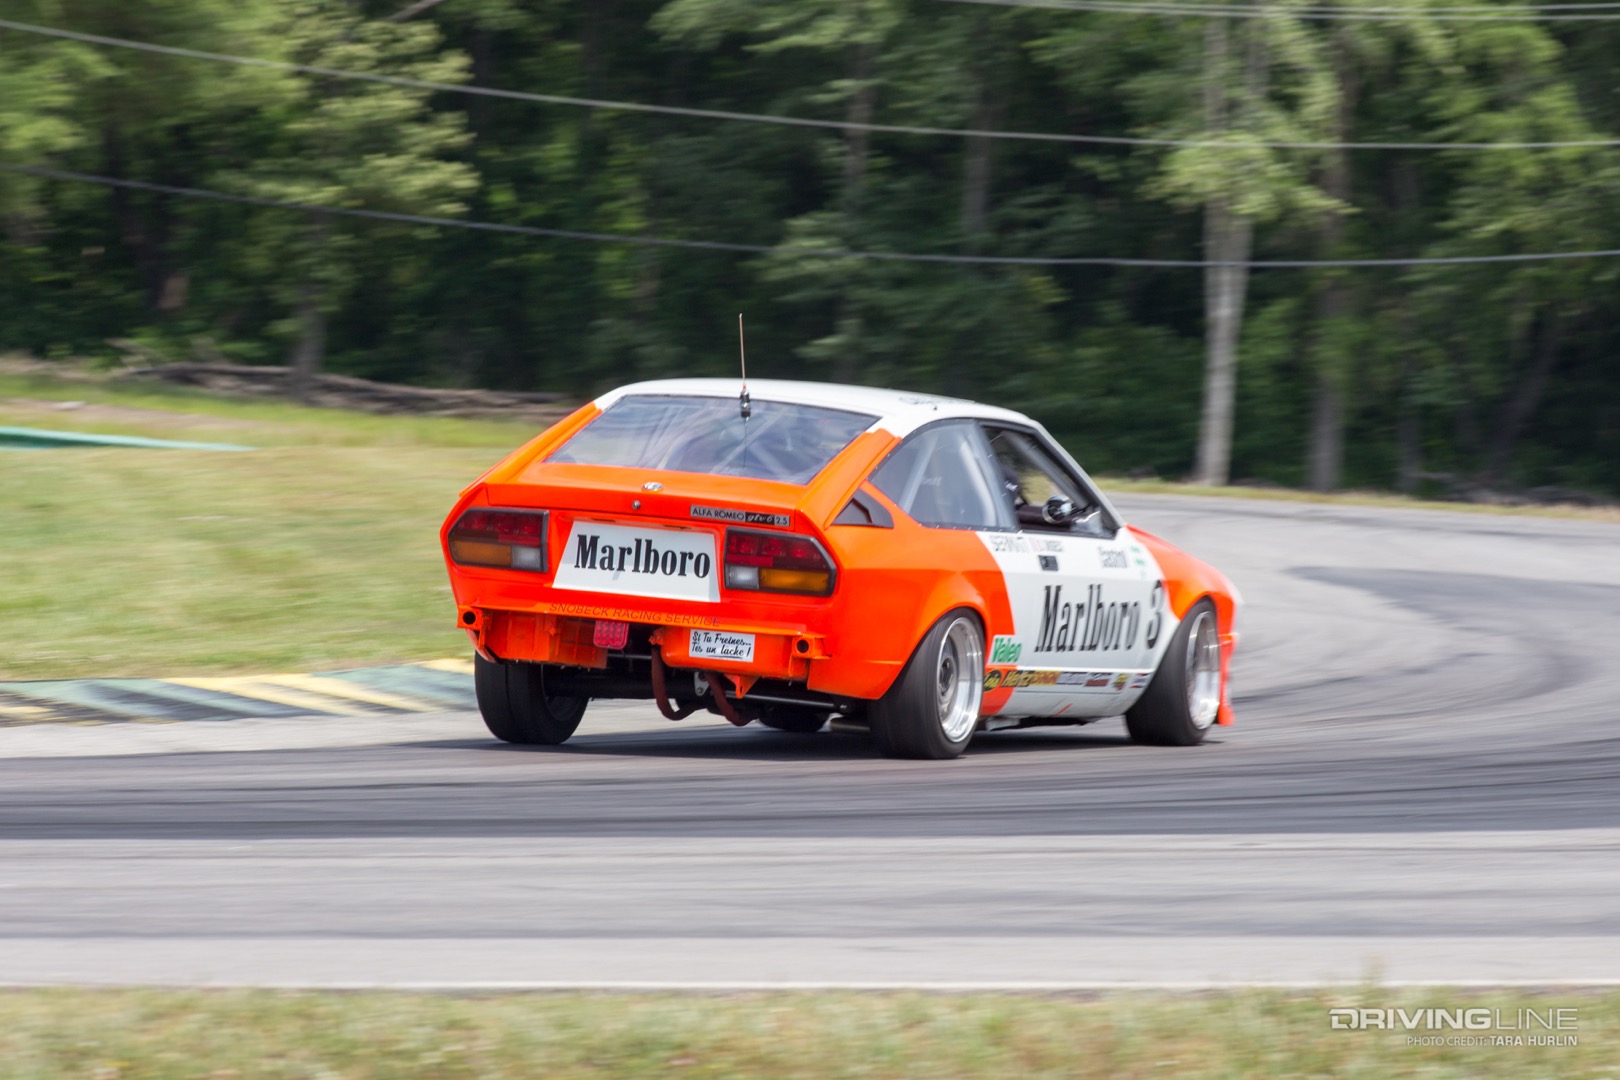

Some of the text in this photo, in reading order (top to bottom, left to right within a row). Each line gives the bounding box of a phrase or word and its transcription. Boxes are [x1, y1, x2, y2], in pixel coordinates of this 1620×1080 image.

[692, 507, 713, 518] ALFA
[714, 511, 745, 521] ROMEO
[776, 516, 788, 526] 2.5
[574, 534, 711, 579] Marlboro
[549, 602, 721, 628] SNOBECK RACING SERVICE
[1035, 579, 1165, 652] Marlboro 3
[703, 632, 713, 643] Tu
[991, 637, 1022, 662] Valeo
